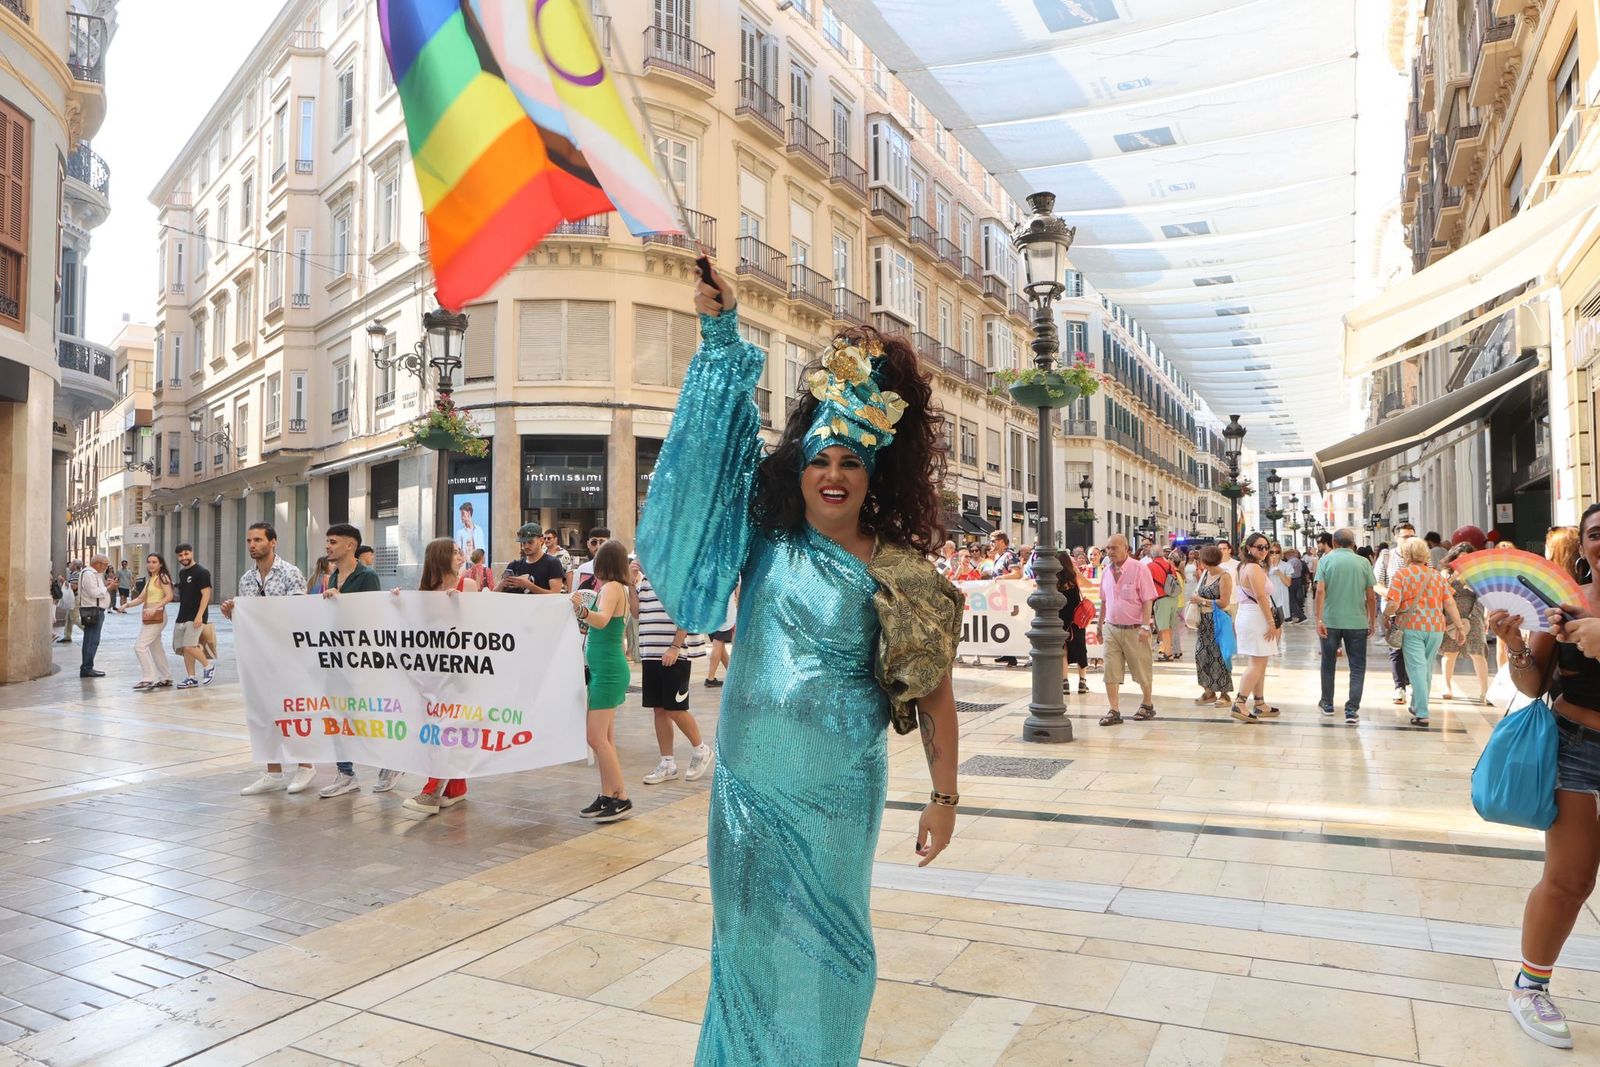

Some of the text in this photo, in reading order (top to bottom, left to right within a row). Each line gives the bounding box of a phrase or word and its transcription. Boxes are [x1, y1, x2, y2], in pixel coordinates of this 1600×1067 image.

[526, 473, 602, 482] intimissimi
[293, 627, 516, 652] PLANTA UN HOMÓFOBO
[319, 652, 494, 675] EN CADA CAVERNA
[283, 696, 402, 713] RENATURALIZA
[426, 701, 523, 725] CAMINA CON
[275, 717, 407, 741] TU BARRIO
[419, 724, 533, 752] ORGULLO
